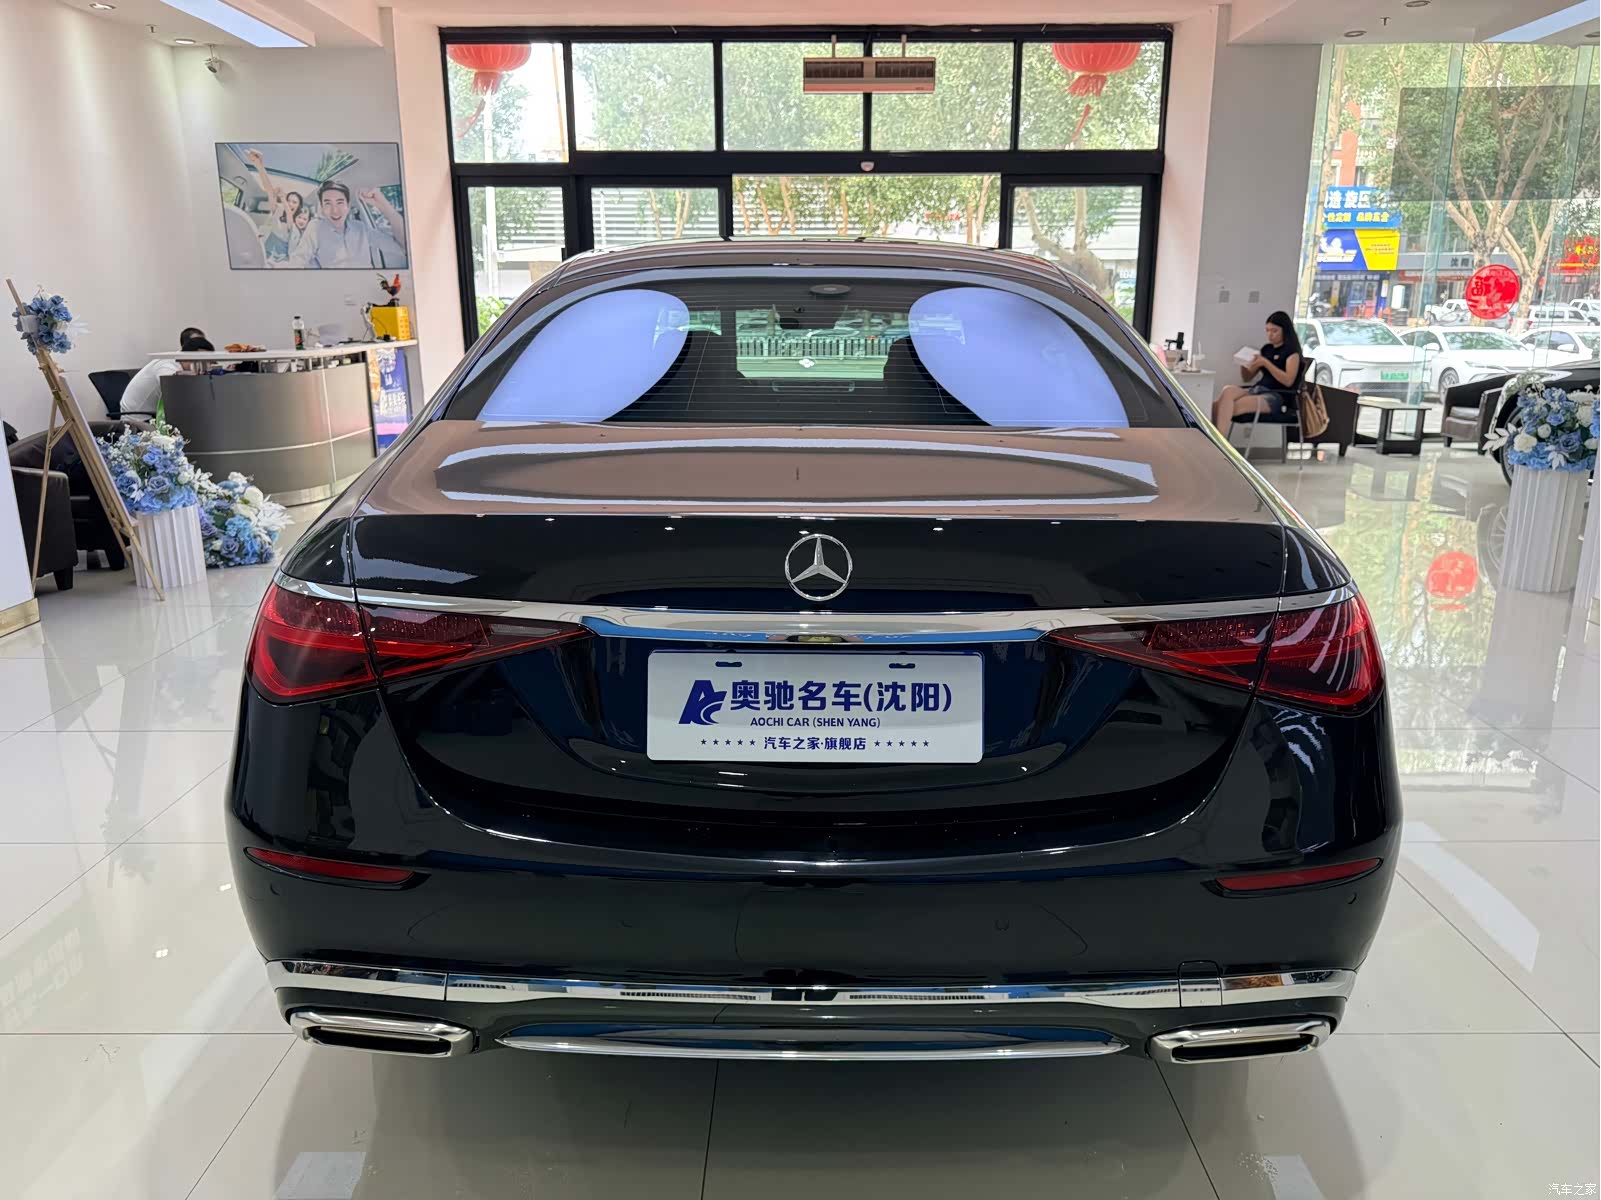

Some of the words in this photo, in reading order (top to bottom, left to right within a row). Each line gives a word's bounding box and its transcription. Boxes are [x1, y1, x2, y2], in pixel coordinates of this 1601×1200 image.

[730, 680, 952, 713] 奥驰名车(沈阳)
[750, 716, 784, 728] AOCHI
[786, 716, 810, 728] CAR
[812, 716, 845, 729] (SHEN
[846, 716, 881, 729] YANG)
